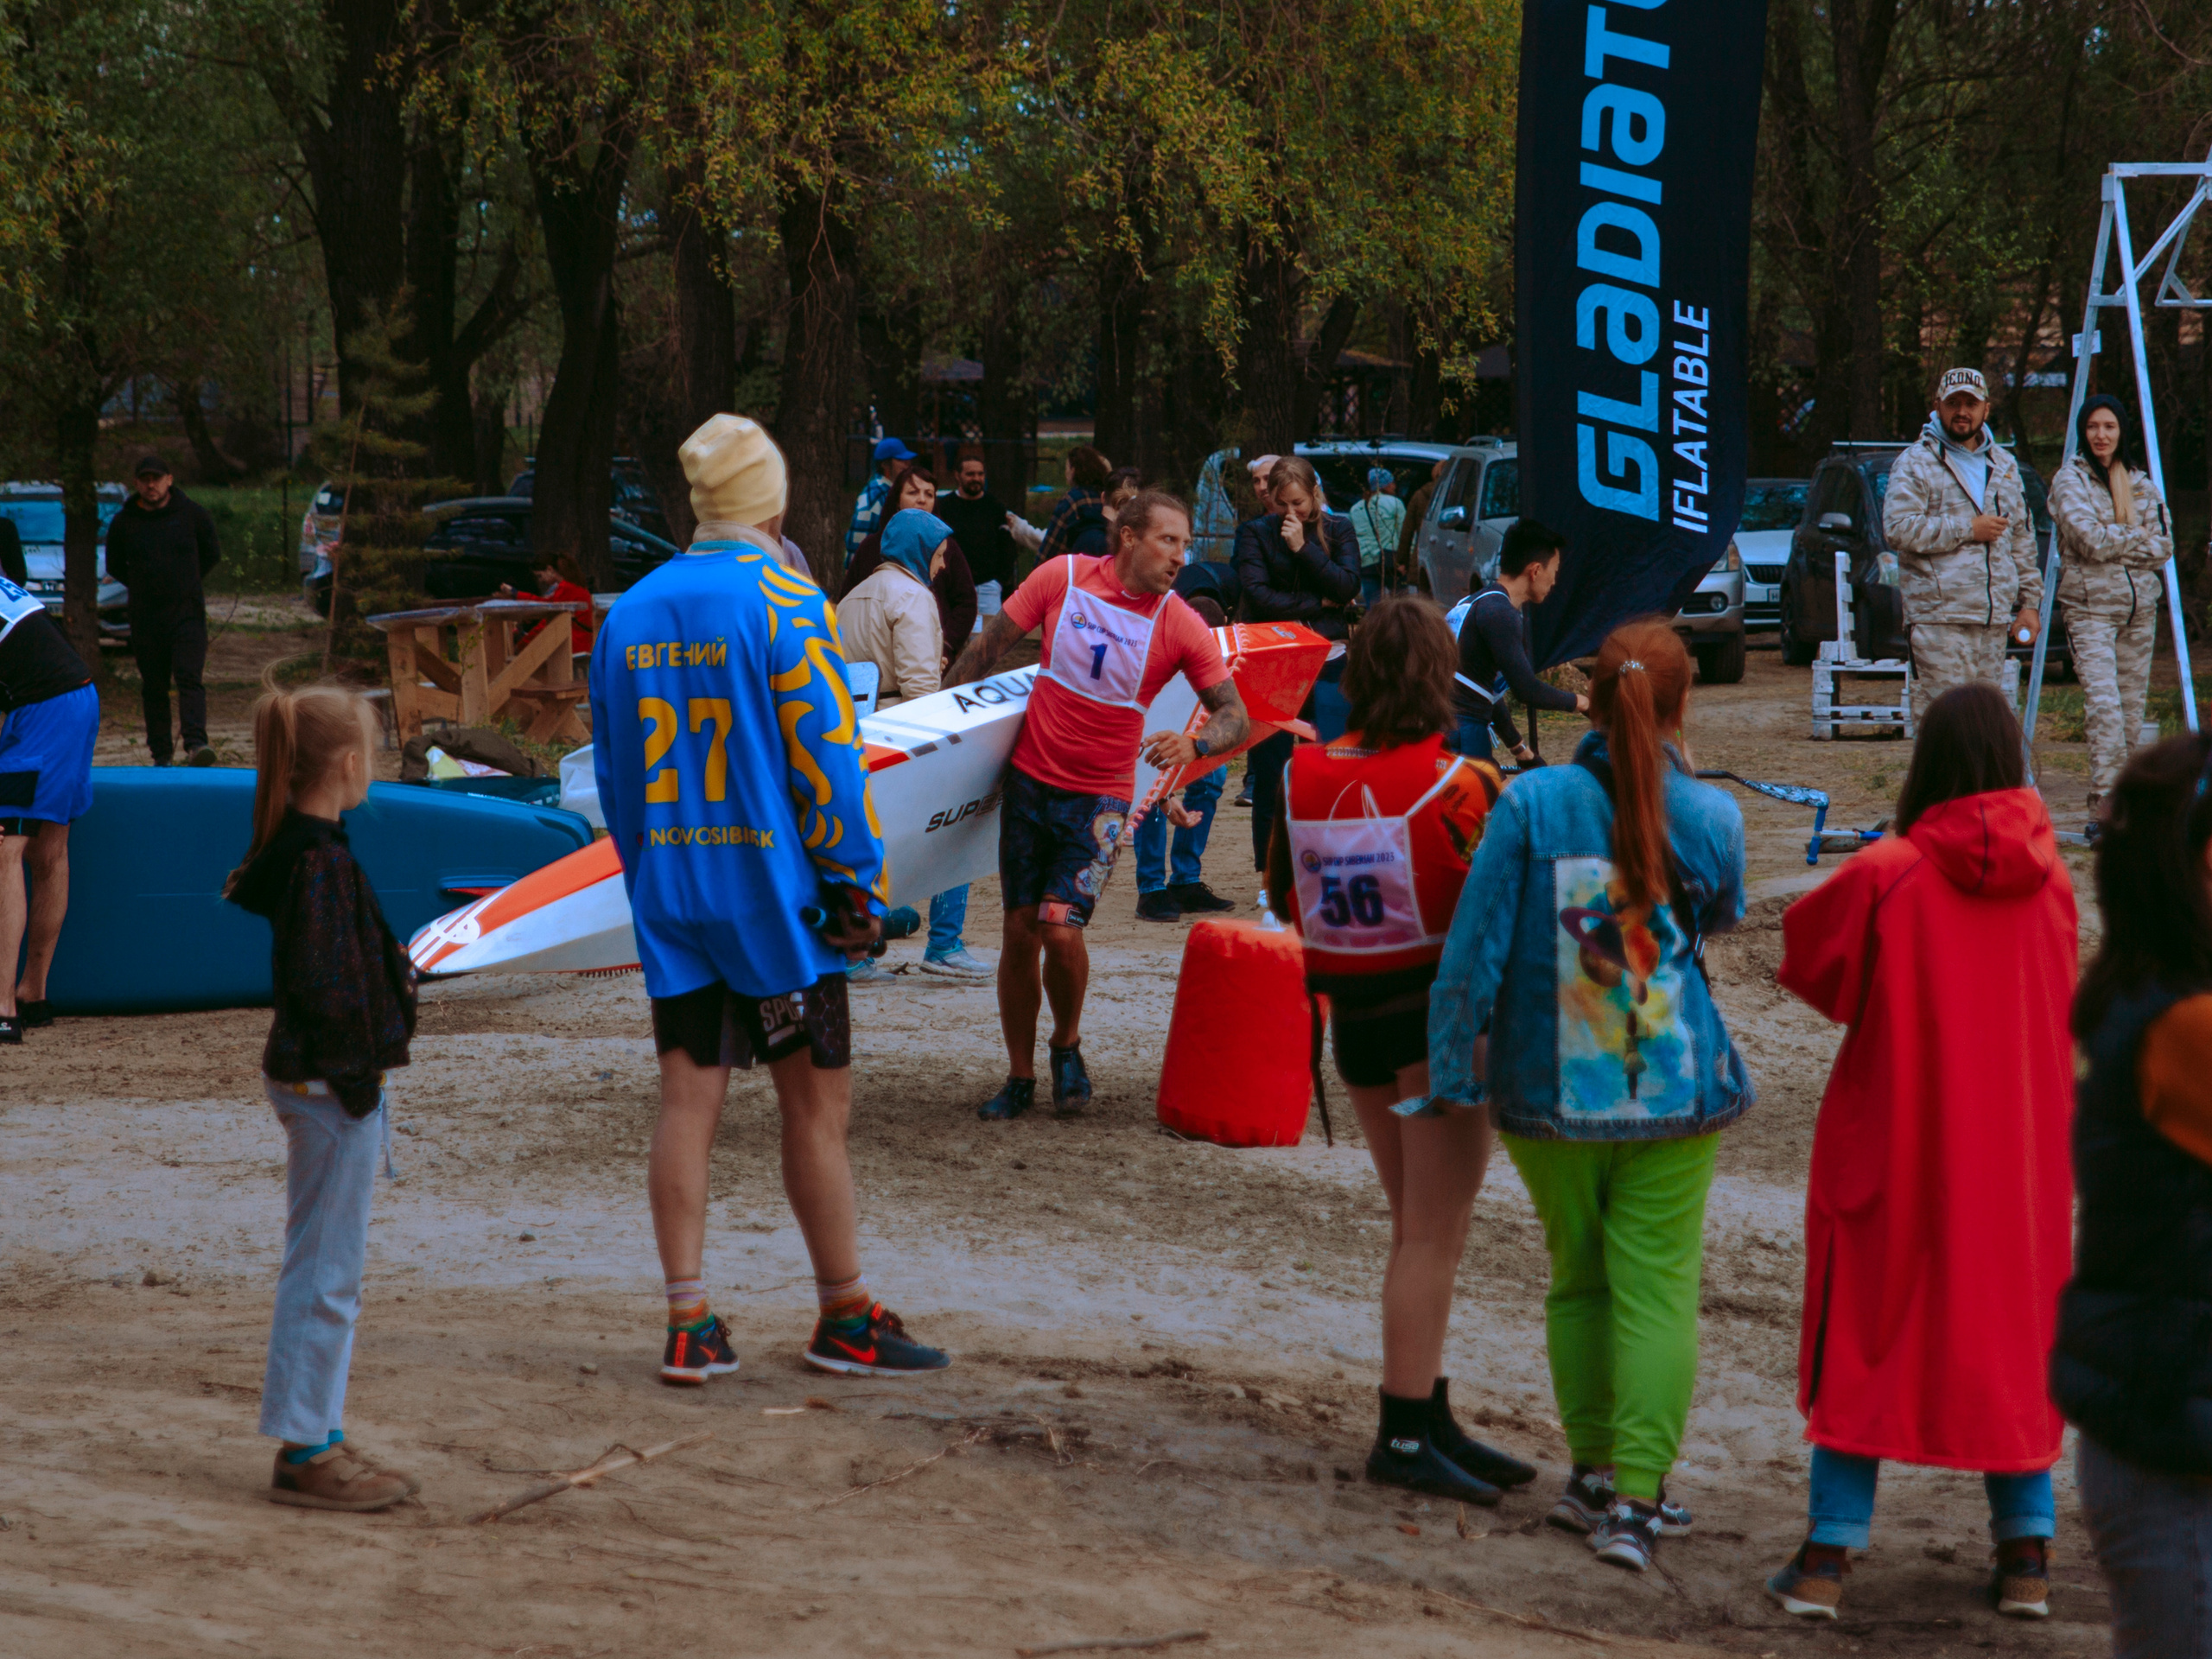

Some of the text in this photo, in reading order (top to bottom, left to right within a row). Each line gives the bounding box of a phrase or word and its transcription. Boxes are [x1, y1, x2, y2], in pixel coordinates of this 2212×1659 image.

[1576, 0, 1670, 522] GLaDIaT
[1673, 300, 1709, 533] IFLATABLE
[626, 636, 728, 671] ЕВГЕНИЙ
[1090, 643, 1108, 681] 1
[638, 696, 733, 804] 27
[1376, 851, 1395, 863] 2023
[1319, 874, 1384, 927] 56
